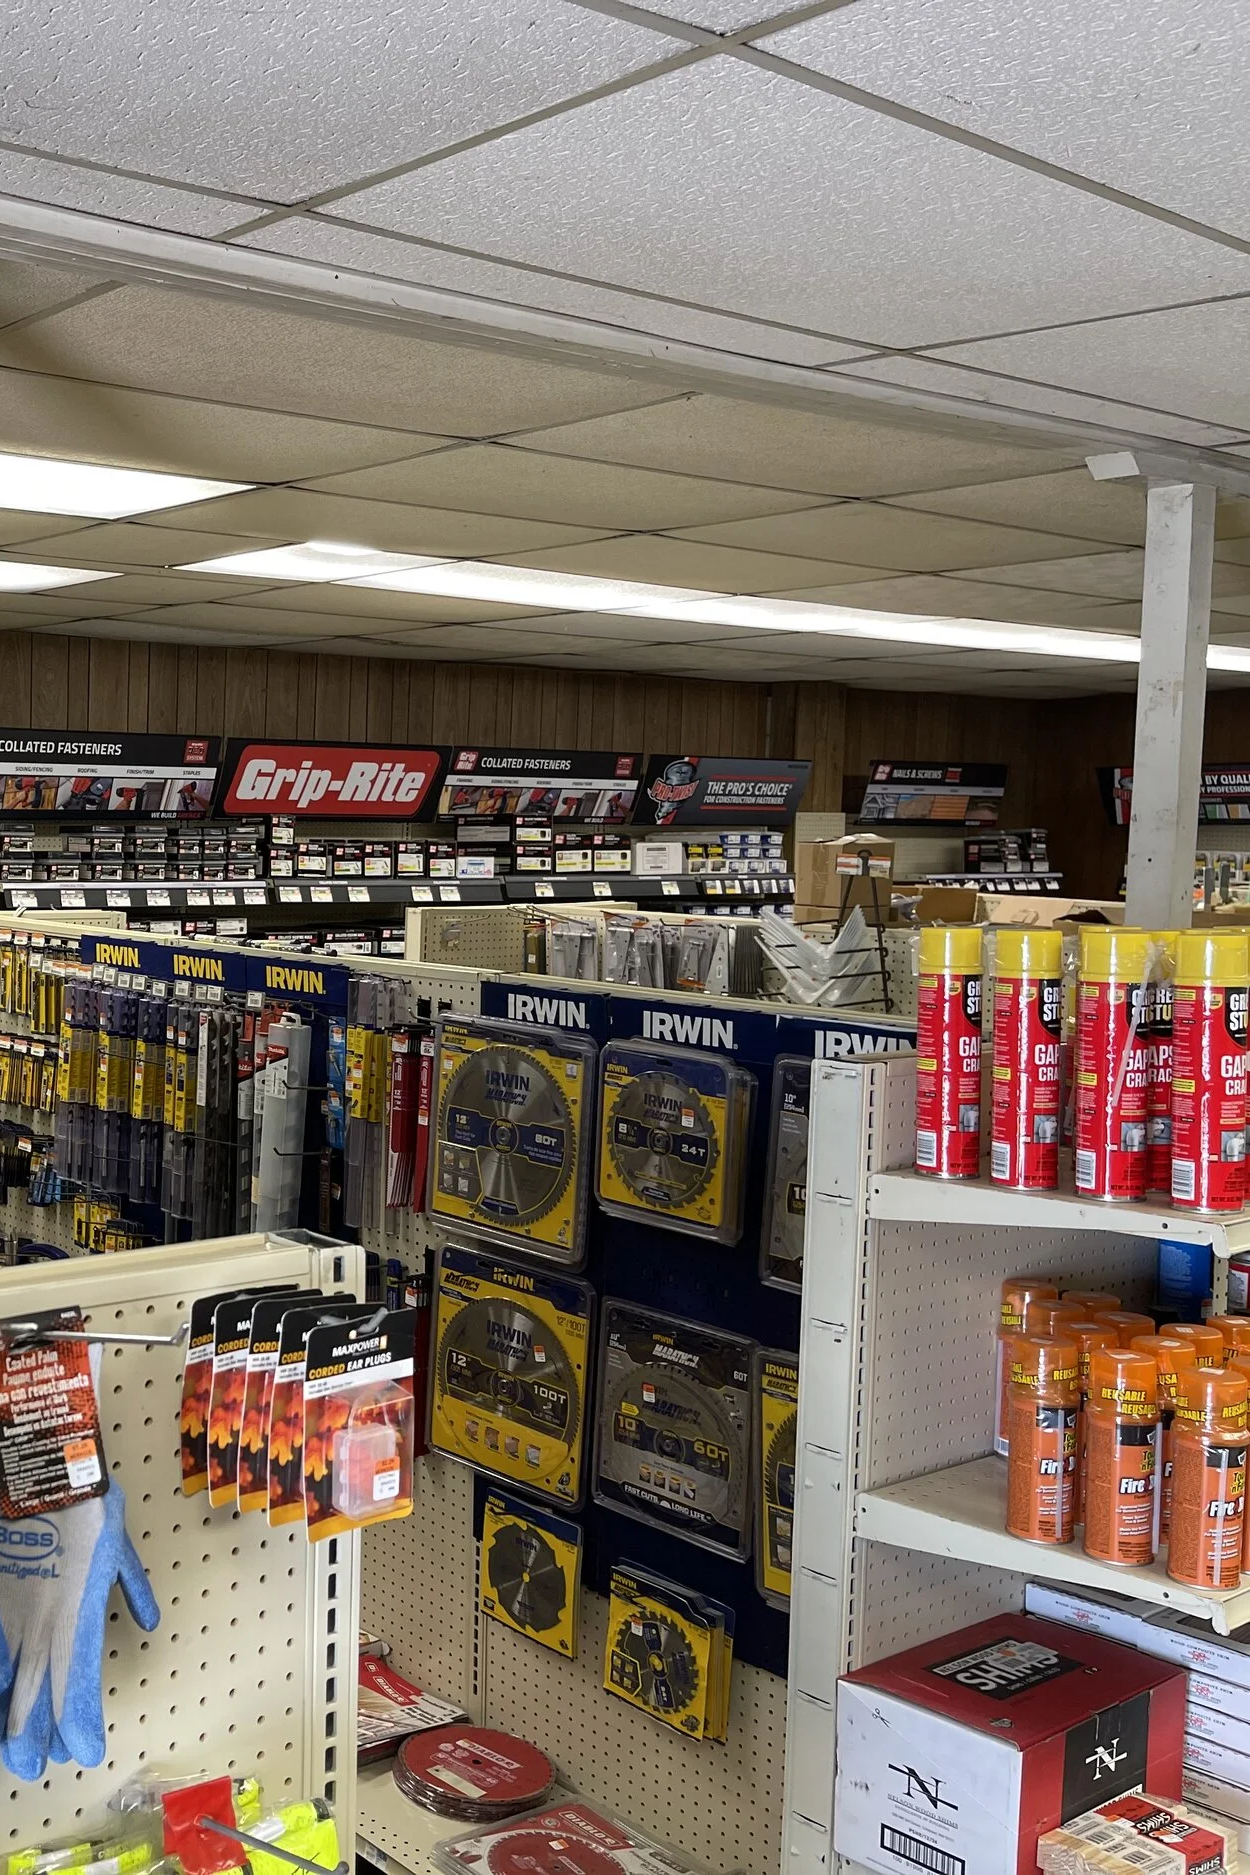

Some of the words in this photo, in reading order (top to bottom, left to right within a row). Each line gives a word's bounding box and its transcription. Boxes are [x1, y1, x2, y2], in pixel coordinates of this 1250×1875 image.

[57, 742, 122, 756] FASTENERS
[481, 757, 523, 769] COLLATED
[524, 758, 571, 770] FASTENERS
[236, 757, 427, 808] Grip-Rite
[892, 769, 910, 779] NAILS
[917, 769, 943, 779] SCREWS
[1205, 775, 1218, 785] BY
[707, 781, 725, 794] THE
[726, 782, 753, 795] PRO'S
[716, 796, 755, 804] CONSTRUCTION
[95, 943, 140, 968] IRWIN
[173, 954, 223, 981] IRWIN
[266, 965, 324, 995] IRWIN
[508, 993, 585, 1029] IRWIN
[643, 1011, 733, 1049] IRWIN
[607, 1063, 628, 1075] IRWIN
[486, 1070, 530, 1092] IRWIN
[643, 1093, 683, 1112] IRWIN
[681, 1143, 706, 1157] 24T
[493, 1266, 535, 1291] IRWIN
[487, 1319, 533, 1347] IRWIN
[332, 1337, 380, 1358] MAXPOWER
[38, 1350, 59, 1366] Palm
[308, 1363, 346, 1380] CORDED
[346, 1359, 363, 1372] EAR
[364, 1352, 392, 1368] PLUGS
[733, 1370, 748, 1382] 60T
[765, 1363, 798, 1380] IRWIN
[533, 1384, 567, 1405] 100T
[1101, 1387, 1146, 1402] REUSABLE
[693, 1441, 729, 1462] 60T
[1120, 1478, 1145, 1494] Fire
[624, 1485, 639, 1497] FAST
[671, 1503, 689, 1516] LONG
[515, 1535, 538, 1551] IRWIN
[612, 1572, 638, 1590] IRWIN
[1186, 1644, 1215, 1656] COMPOSITE
[937, 1659, 968, 1673] NELSON
[887, 1793, 913, 1811] NELSON
[915, 1803, 936, 1819] WOOD
[563, 1811, 608, 1840] DIABLO
